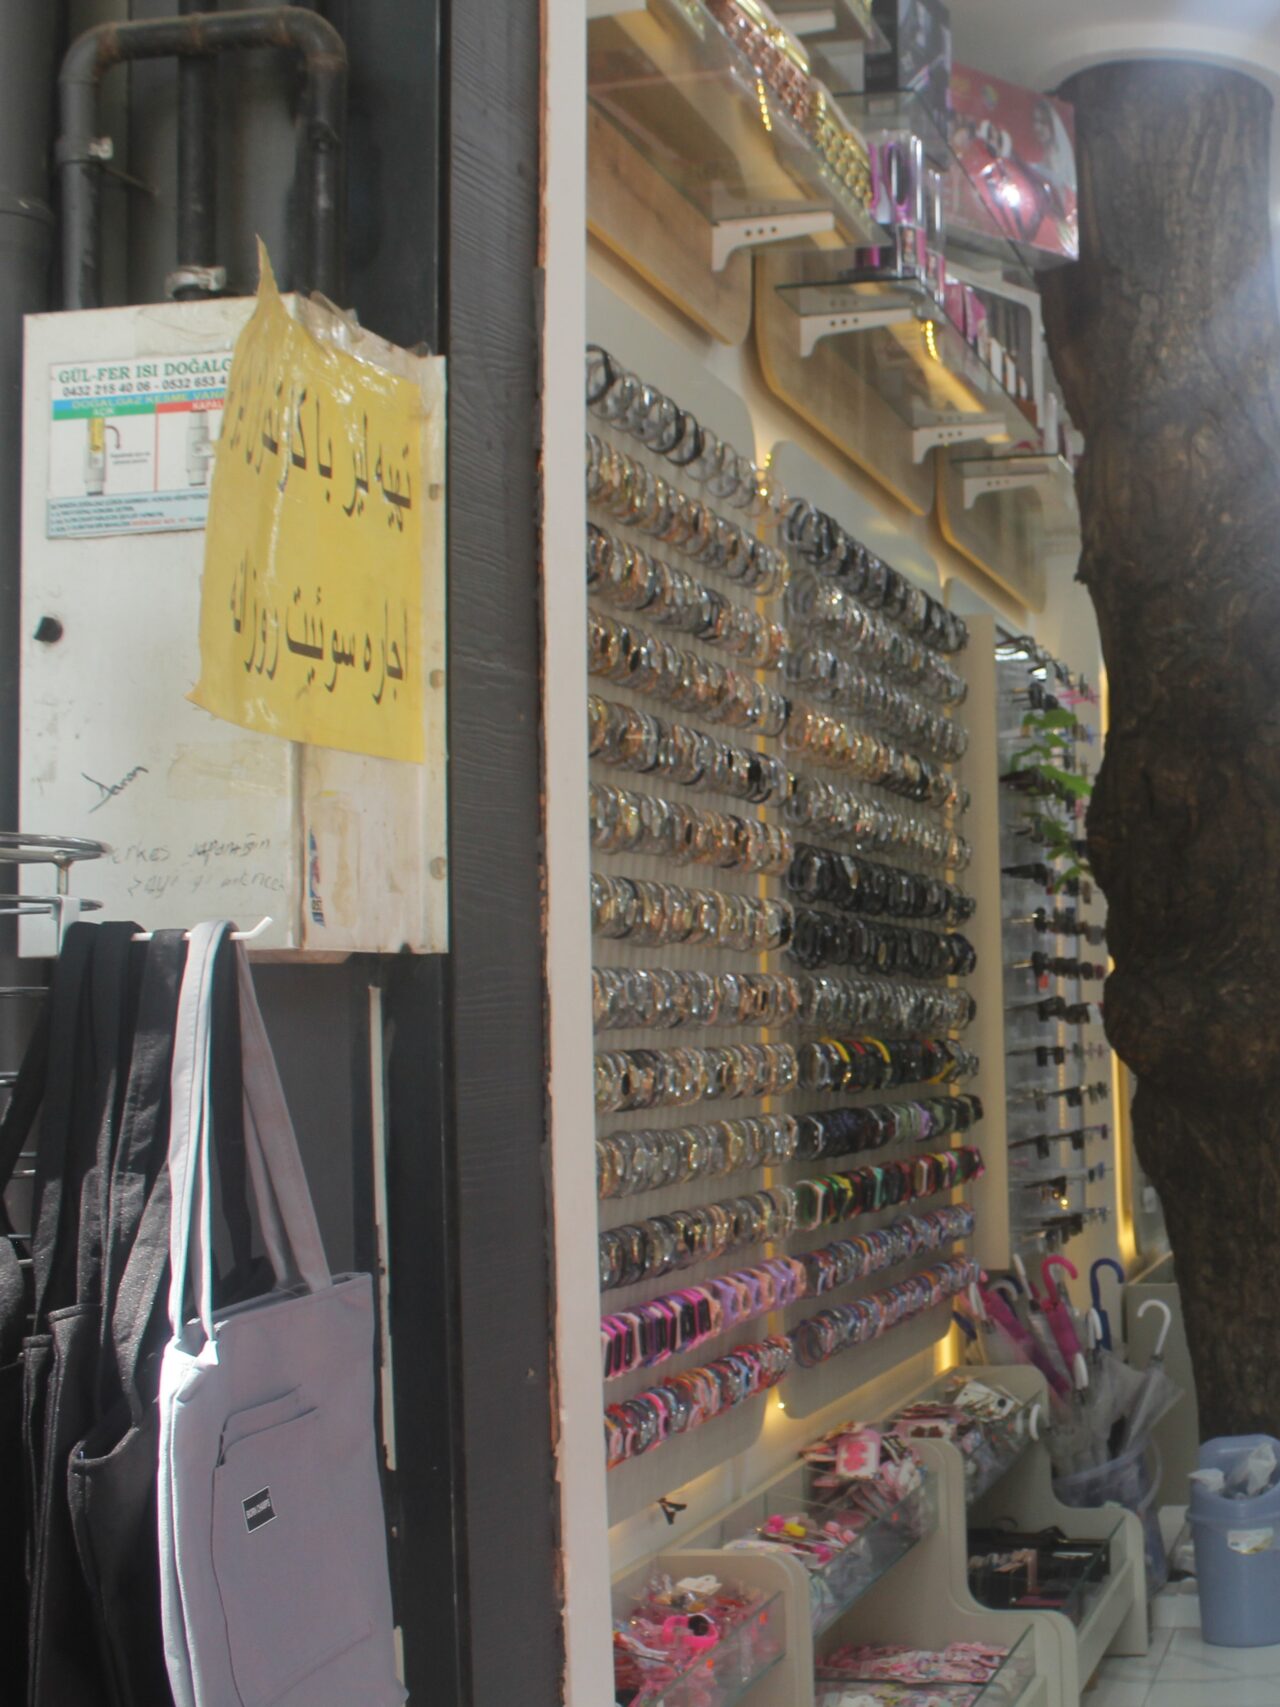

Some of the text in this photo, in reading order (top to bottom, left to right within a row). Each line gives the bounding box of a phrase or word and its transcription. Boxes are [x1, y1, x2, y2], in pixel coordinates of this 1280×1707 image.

[58, 358, 232, 384] GÜL-FER ISI DOĞALG
